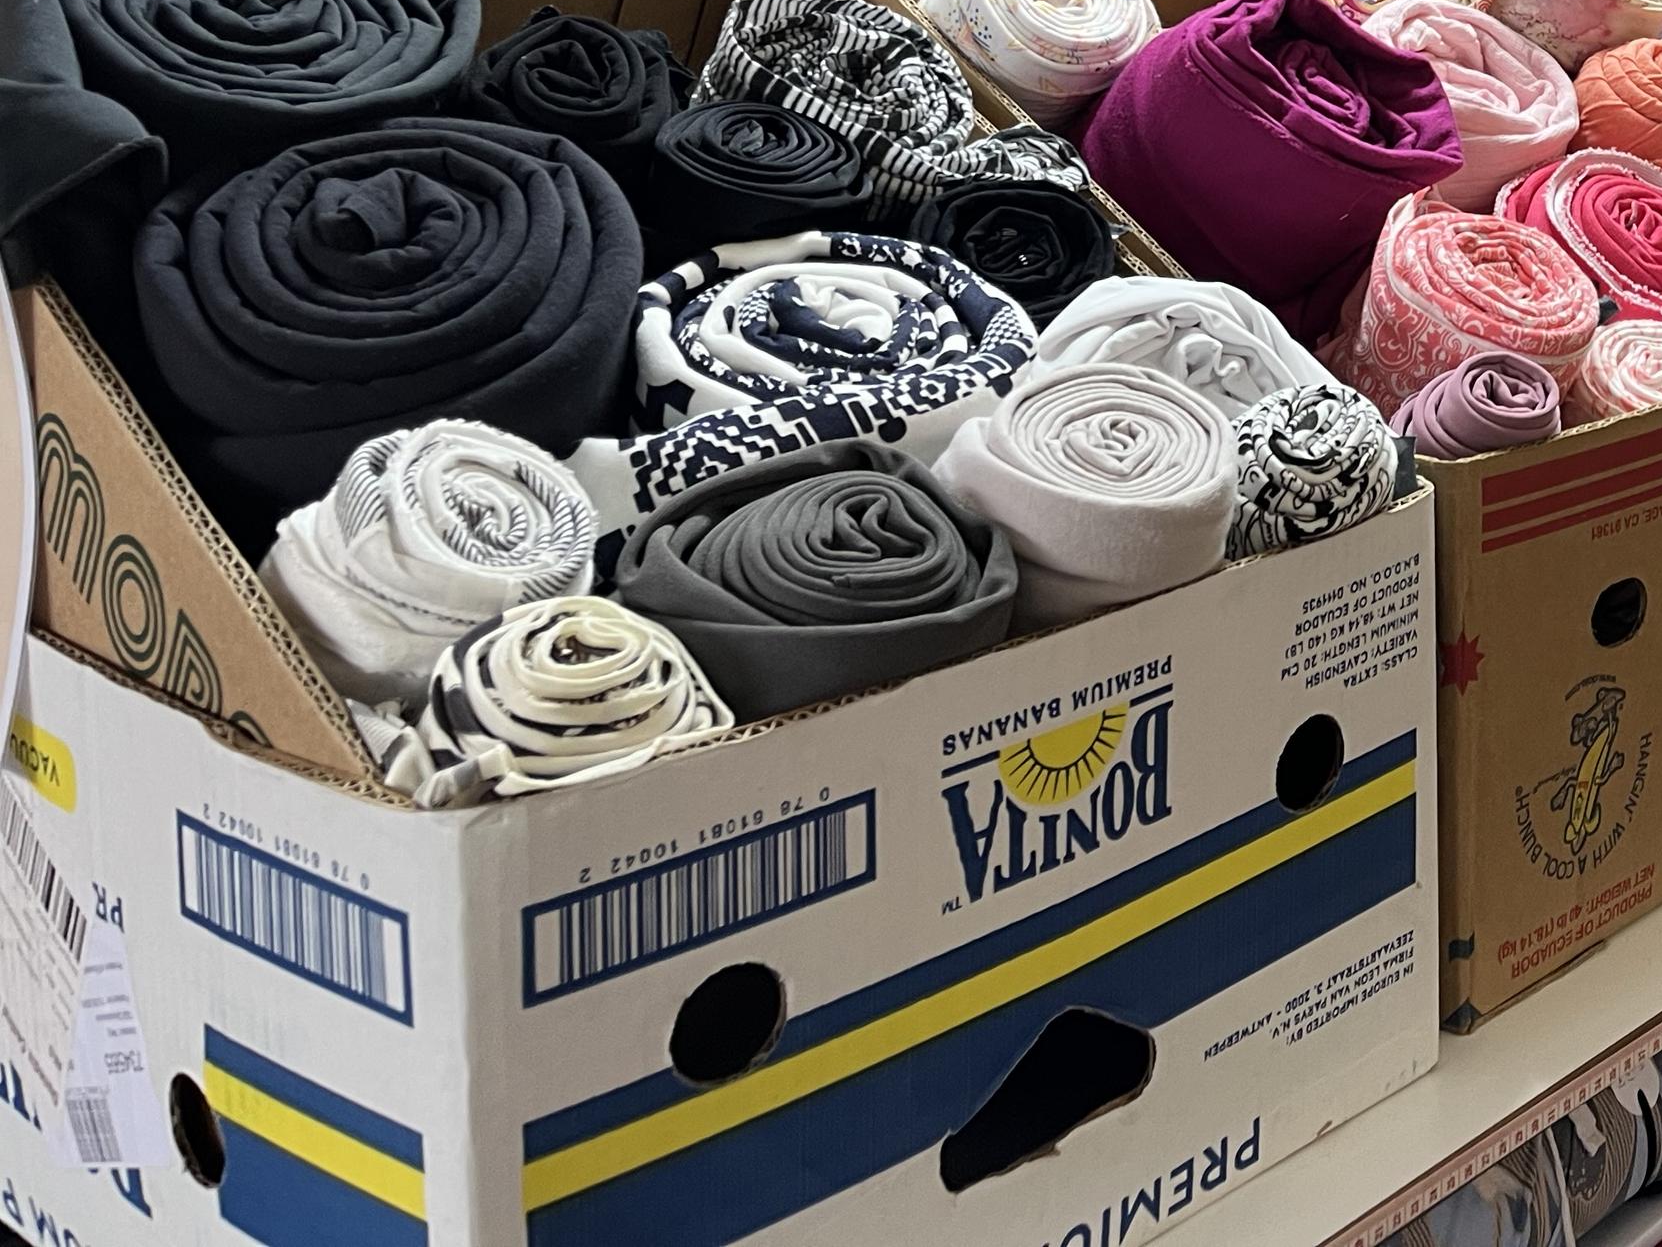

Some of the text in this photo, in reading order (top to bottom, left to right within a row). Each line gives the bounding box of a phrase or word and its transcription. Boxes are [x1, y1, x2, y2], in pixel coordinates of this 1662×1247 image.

[1623, 513, 1640, 530] CA
[1295, 572, 1419, 637] PRODUCT OF ECUADOR
[1377, 602, 1396, 619] WT:
[1400, 590, 1419, 609] NET
[1280, 609, 1419, 682] MINIMUM LENGTH: 20 CM
[1285, 641, 1304, 659] LB)
[1308, 633, 1327, 650] (40
[1330, 624, 1345, 640] KG
[1305, 629, 1418, 689] VARIETY: CAVENDISH
[1343, 646, 1418, 689] CLASS: EXTRA
[941, 654, 1173, 756] PREMIUM BANANAS
[203, 803, 211, 820] 2
[780, 795, 804, 816] 78
[819, 785, 830, 803] 0
[940, 700, 1174, 905] BONITA
[609, 838, 681, 875] 10042
[1593, 821, 1626, 869] WITH
[577, 866, 592, 884] 2
[1542, 851, 1575, 880] COOL
[1578, 853, 1588, 875] A
[1634, 863, 1655, 888] NET
[1585, 877, 1631, 915] WEIGHT:
[1511, 884, 1653, 981] PRODUCT OF ECUADOR
[1269, 946, 1414, 1040] FIRMA LEON VAN PARYS N.V.
[1286, 962, 1414, 1047] IN EUROPE IMPORTED BY:
[1203, 1012, 1273, 1062] ANTWERPEN
[1043, 1116, 1260, 1247] PREMI
